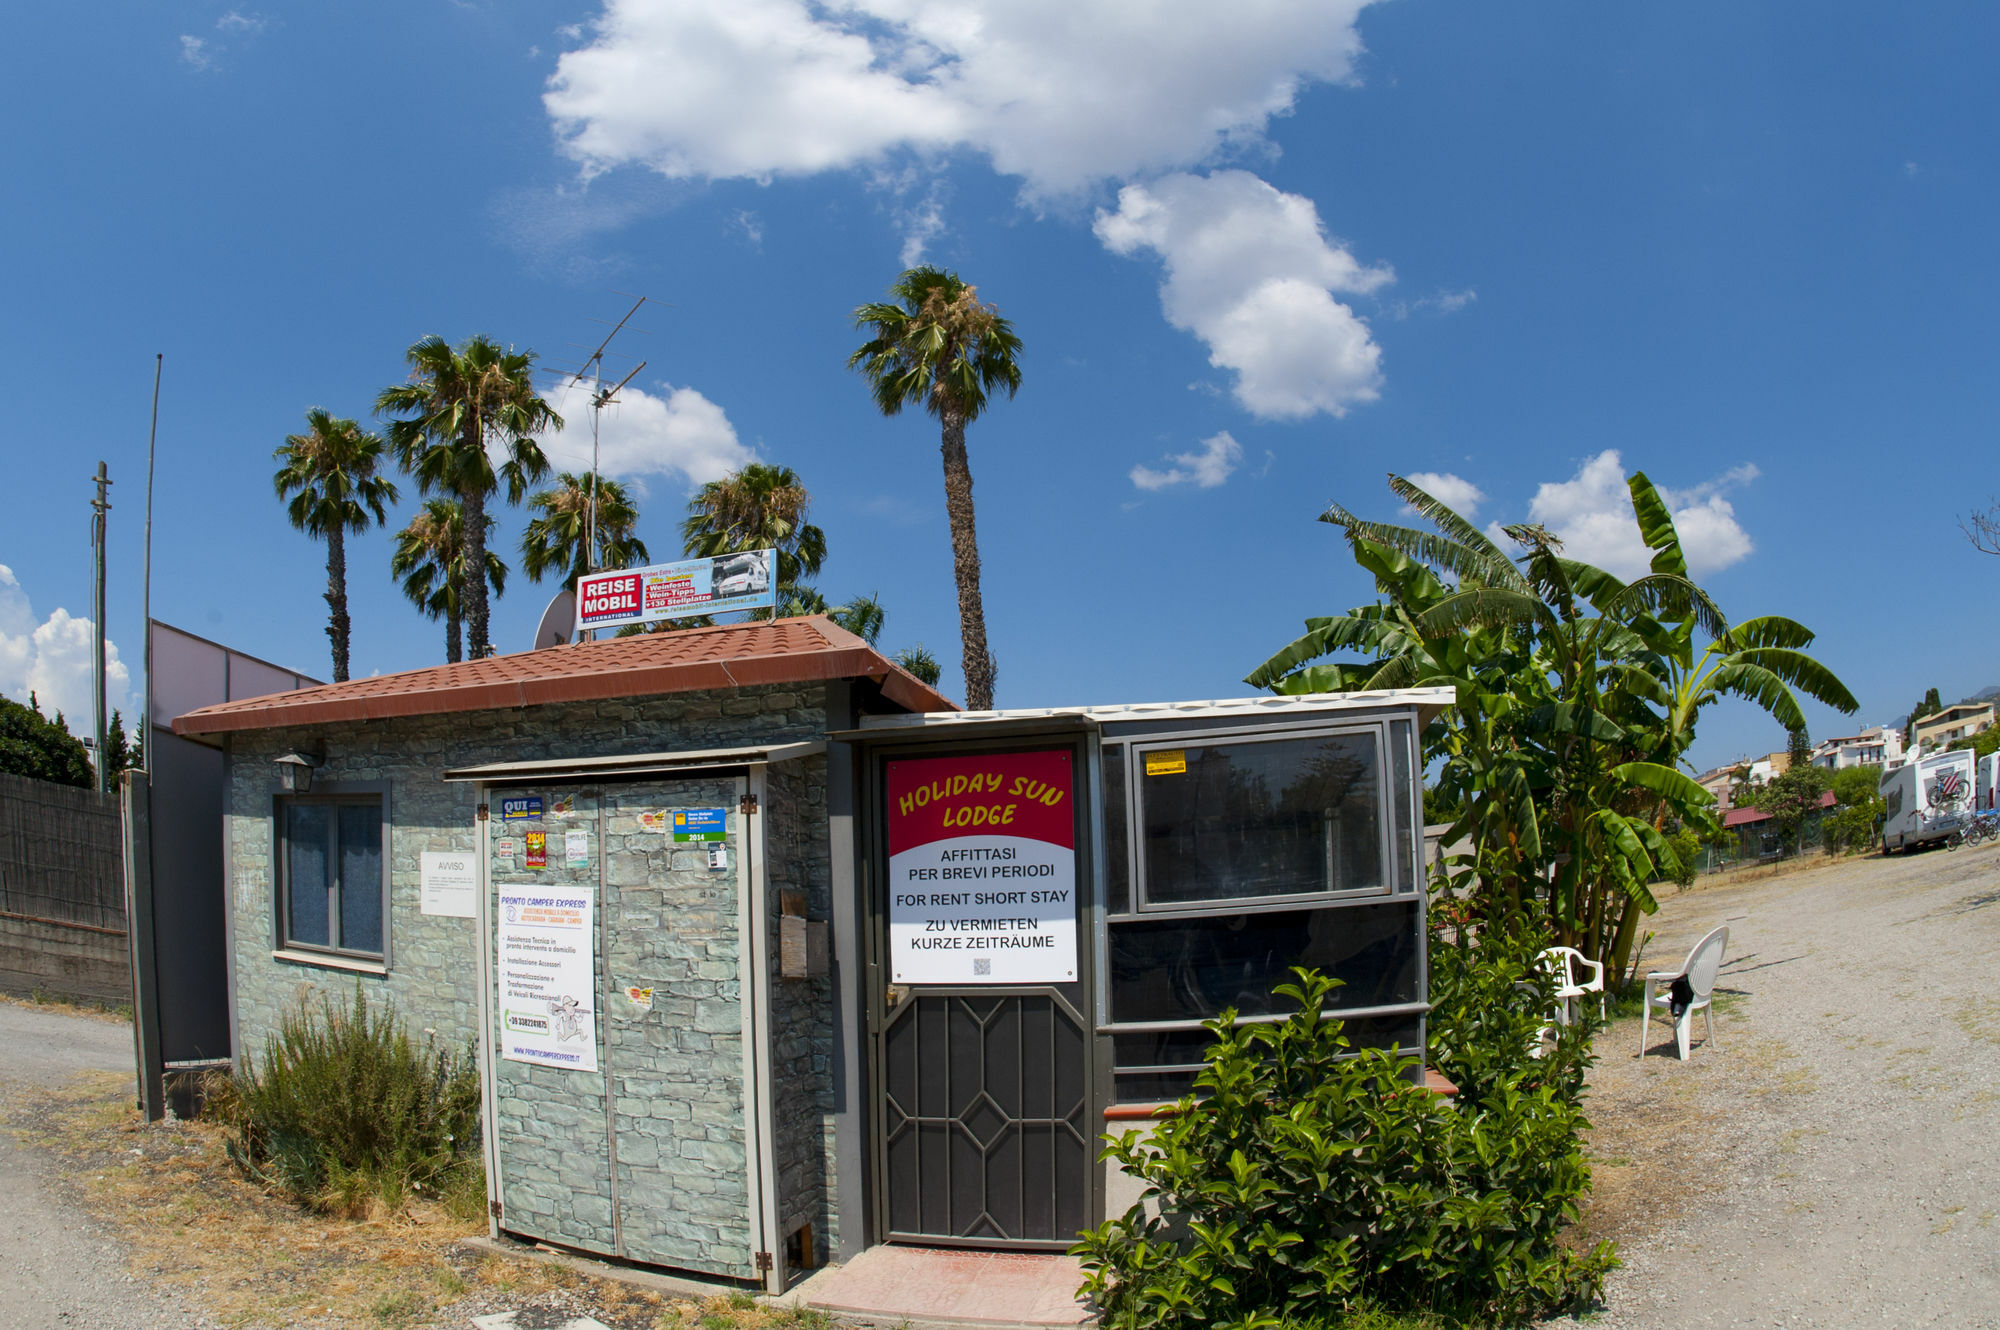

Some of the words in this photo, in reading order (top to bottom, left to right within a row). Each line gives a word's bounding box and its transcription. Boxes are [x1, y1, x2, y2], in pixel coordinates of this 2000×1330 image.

[666, 573, 694, 581] besten
[587, 578, 635, 597] REISE
[650, 581, 690, 591] Weinfeste
[650, 588, 694, 599] Wein-Tipps
[584, 595, 637, 613] MOBIL
[585, 612, 634, 622] INTERNATIONAL
[899, 773, 1003, 816] HOLIDAY
[1008, 777, 1064, 806] SUN
[504, 801, 528, 813] QUI
[943, 804, 1017, 827] LODGE
[527, 833, 545, 844] 2014
[941, 848, 1016, 862] AFFITTASI
[438, 862, 465, 871] AVVISO
[909, 869, 938, 880] PER
[942, 867, 987, 880] BREVI
[992, 864, 1054, 878] PERIODI
[501, 896, 526, 906] PRONTO
[527, 898, 555, 907] CAMPER
[555, 899, 587, 909] EXPRESS
[896, 894, 926, 907] FOR
[930, 893, 971, 906] RENT
[974, 891, 1027, 905] SHORT
[1030, 890, 1069, 903] STAY
[925, 919, 946, 932] ZU
[950, 917, 1038, 931] VERMIETEN
[911, 937, 962, 949] KURZE
[966, 934, 1054, 949] ZEITRÄUME
[507, 957, 538, 966] Installazione
